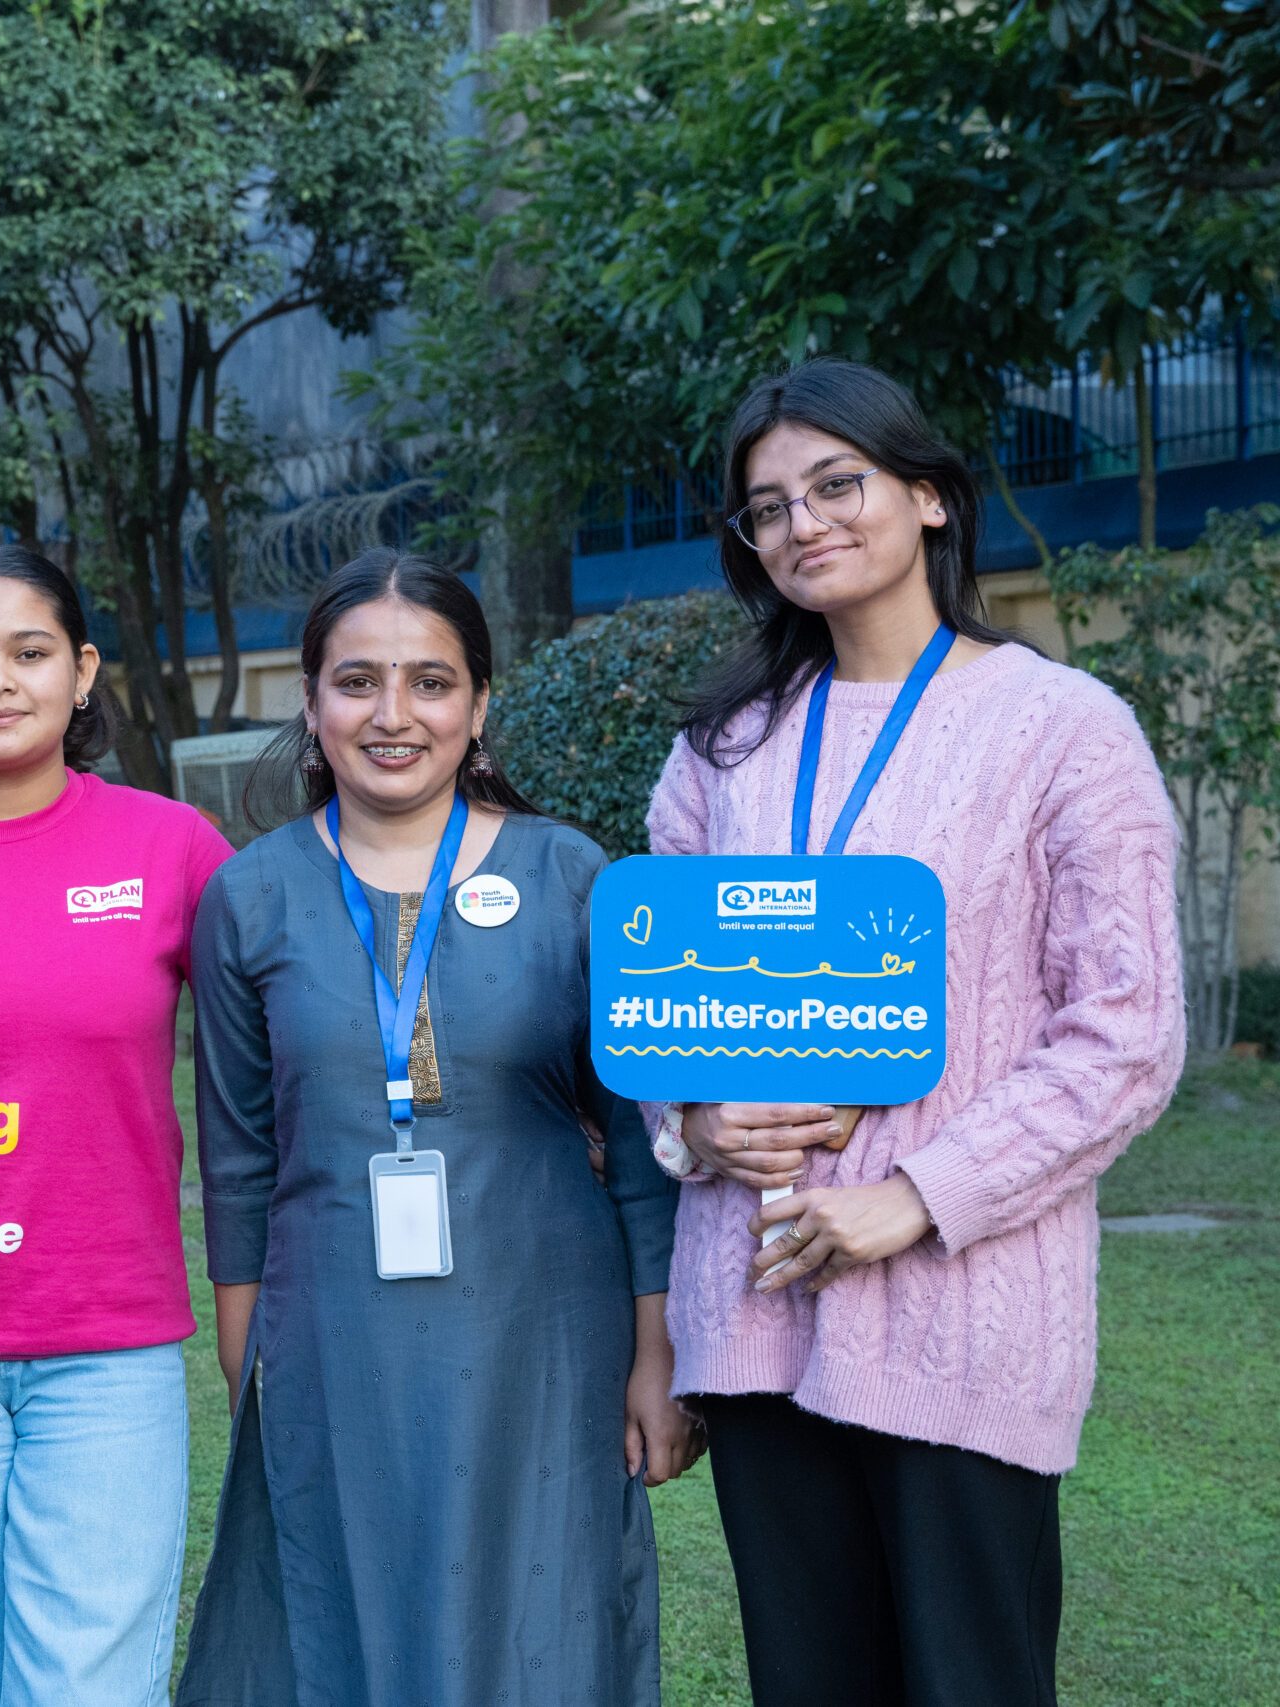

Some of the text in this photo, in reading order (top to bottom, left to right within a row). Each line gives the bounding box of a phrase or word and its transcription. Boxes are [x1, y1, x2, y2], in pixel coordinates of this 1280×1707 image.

[100, 885, 140, 902] PLAN
[759, 888, 811, 902] PLAN
[719, 922, 740, 930] Until
[774, 922, 786, 930] all
[788, 922, 814, 932] equal
[609, 995, 928, 1030] #UniteForPeace
